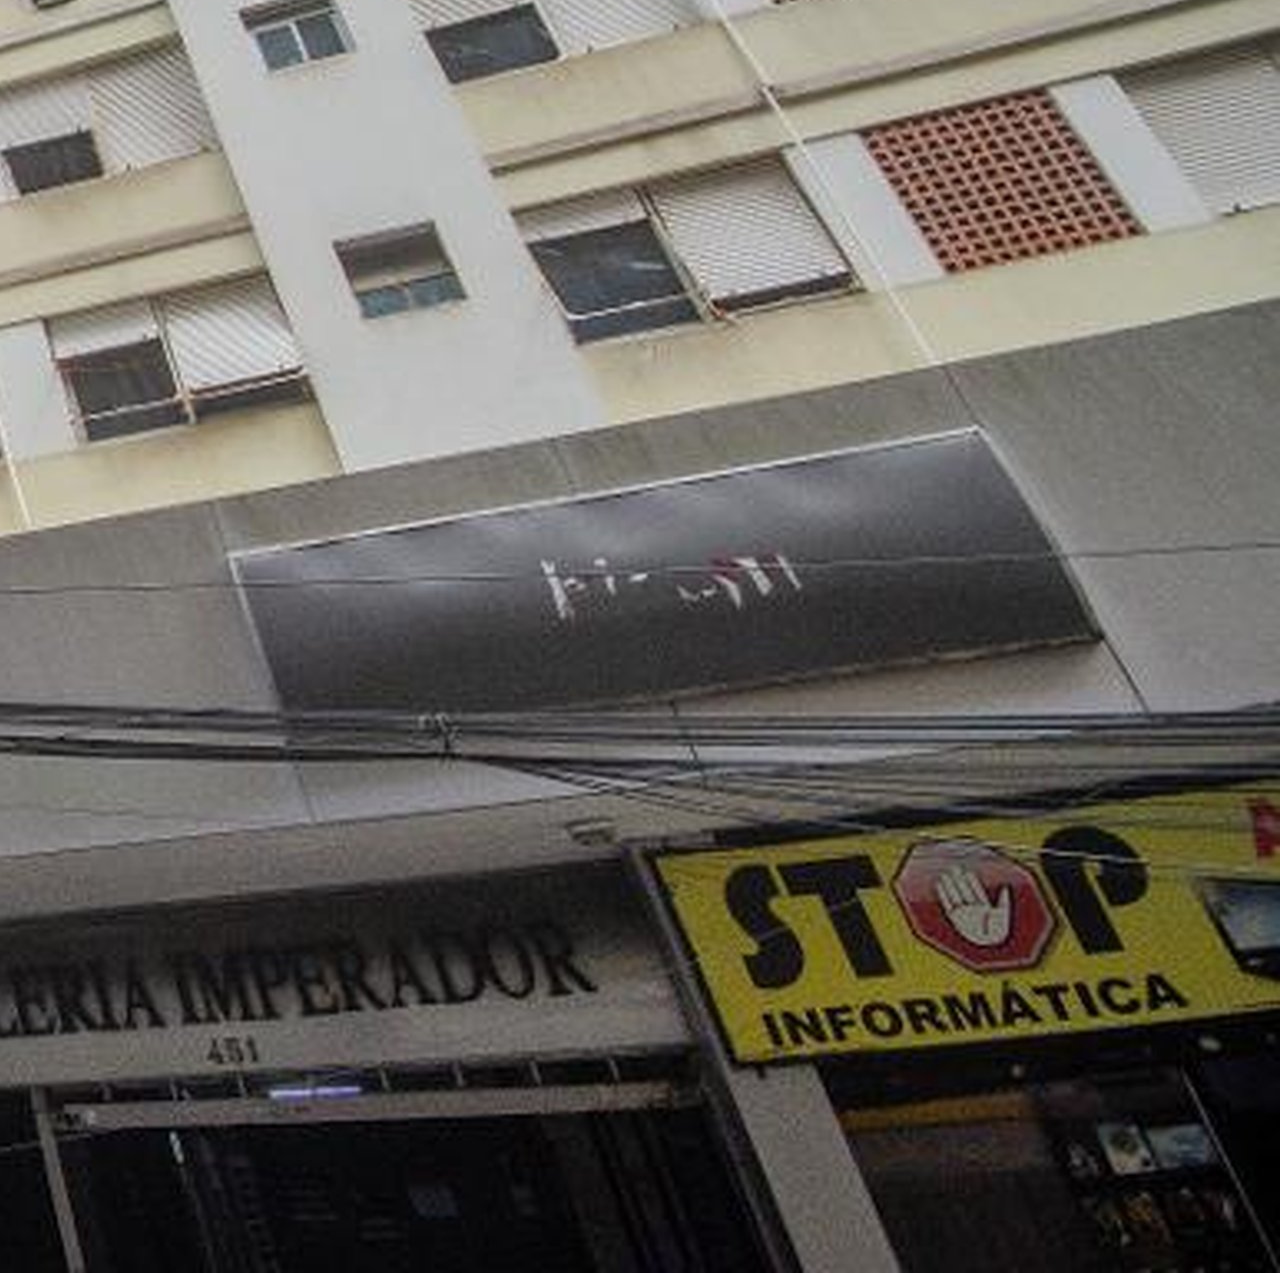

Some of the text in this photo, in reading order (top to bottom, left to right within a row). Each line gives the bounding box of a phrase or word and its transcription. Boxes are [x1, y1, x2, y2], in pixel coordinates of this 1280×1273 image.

[176, 926, 598, 1026] IMPERADOR
[762, 971, 1190, 1049] INFORMÁTICA
[205, 1034, 259, 1065] 451
